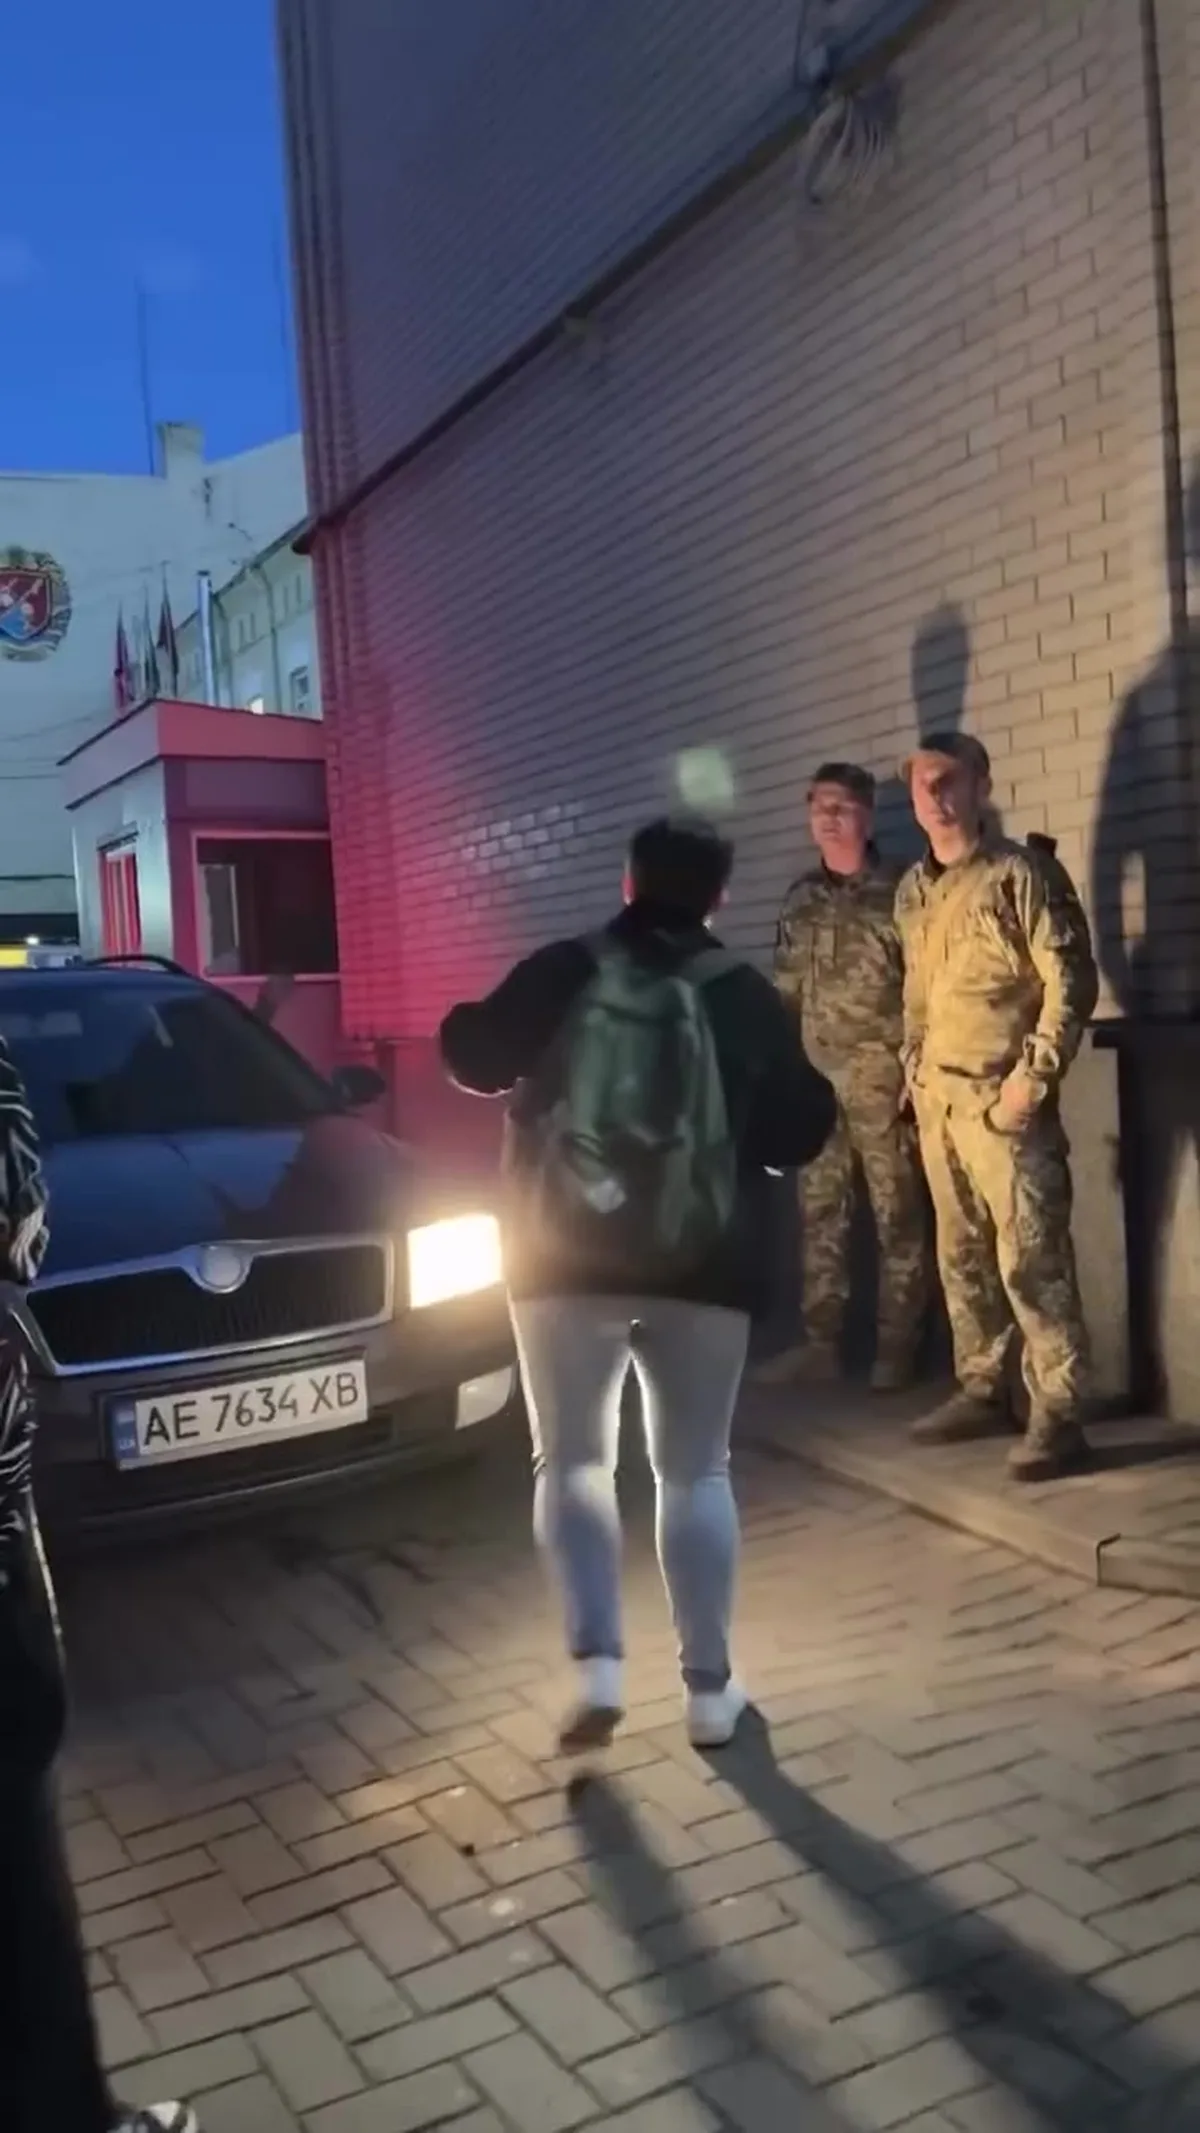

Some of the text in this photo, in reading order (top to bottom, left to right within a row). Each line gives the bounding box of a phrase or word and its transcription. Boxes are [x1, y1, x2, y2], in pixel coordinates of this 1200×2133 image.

[144, 1372, 358, 1446] AE 7634 XB
